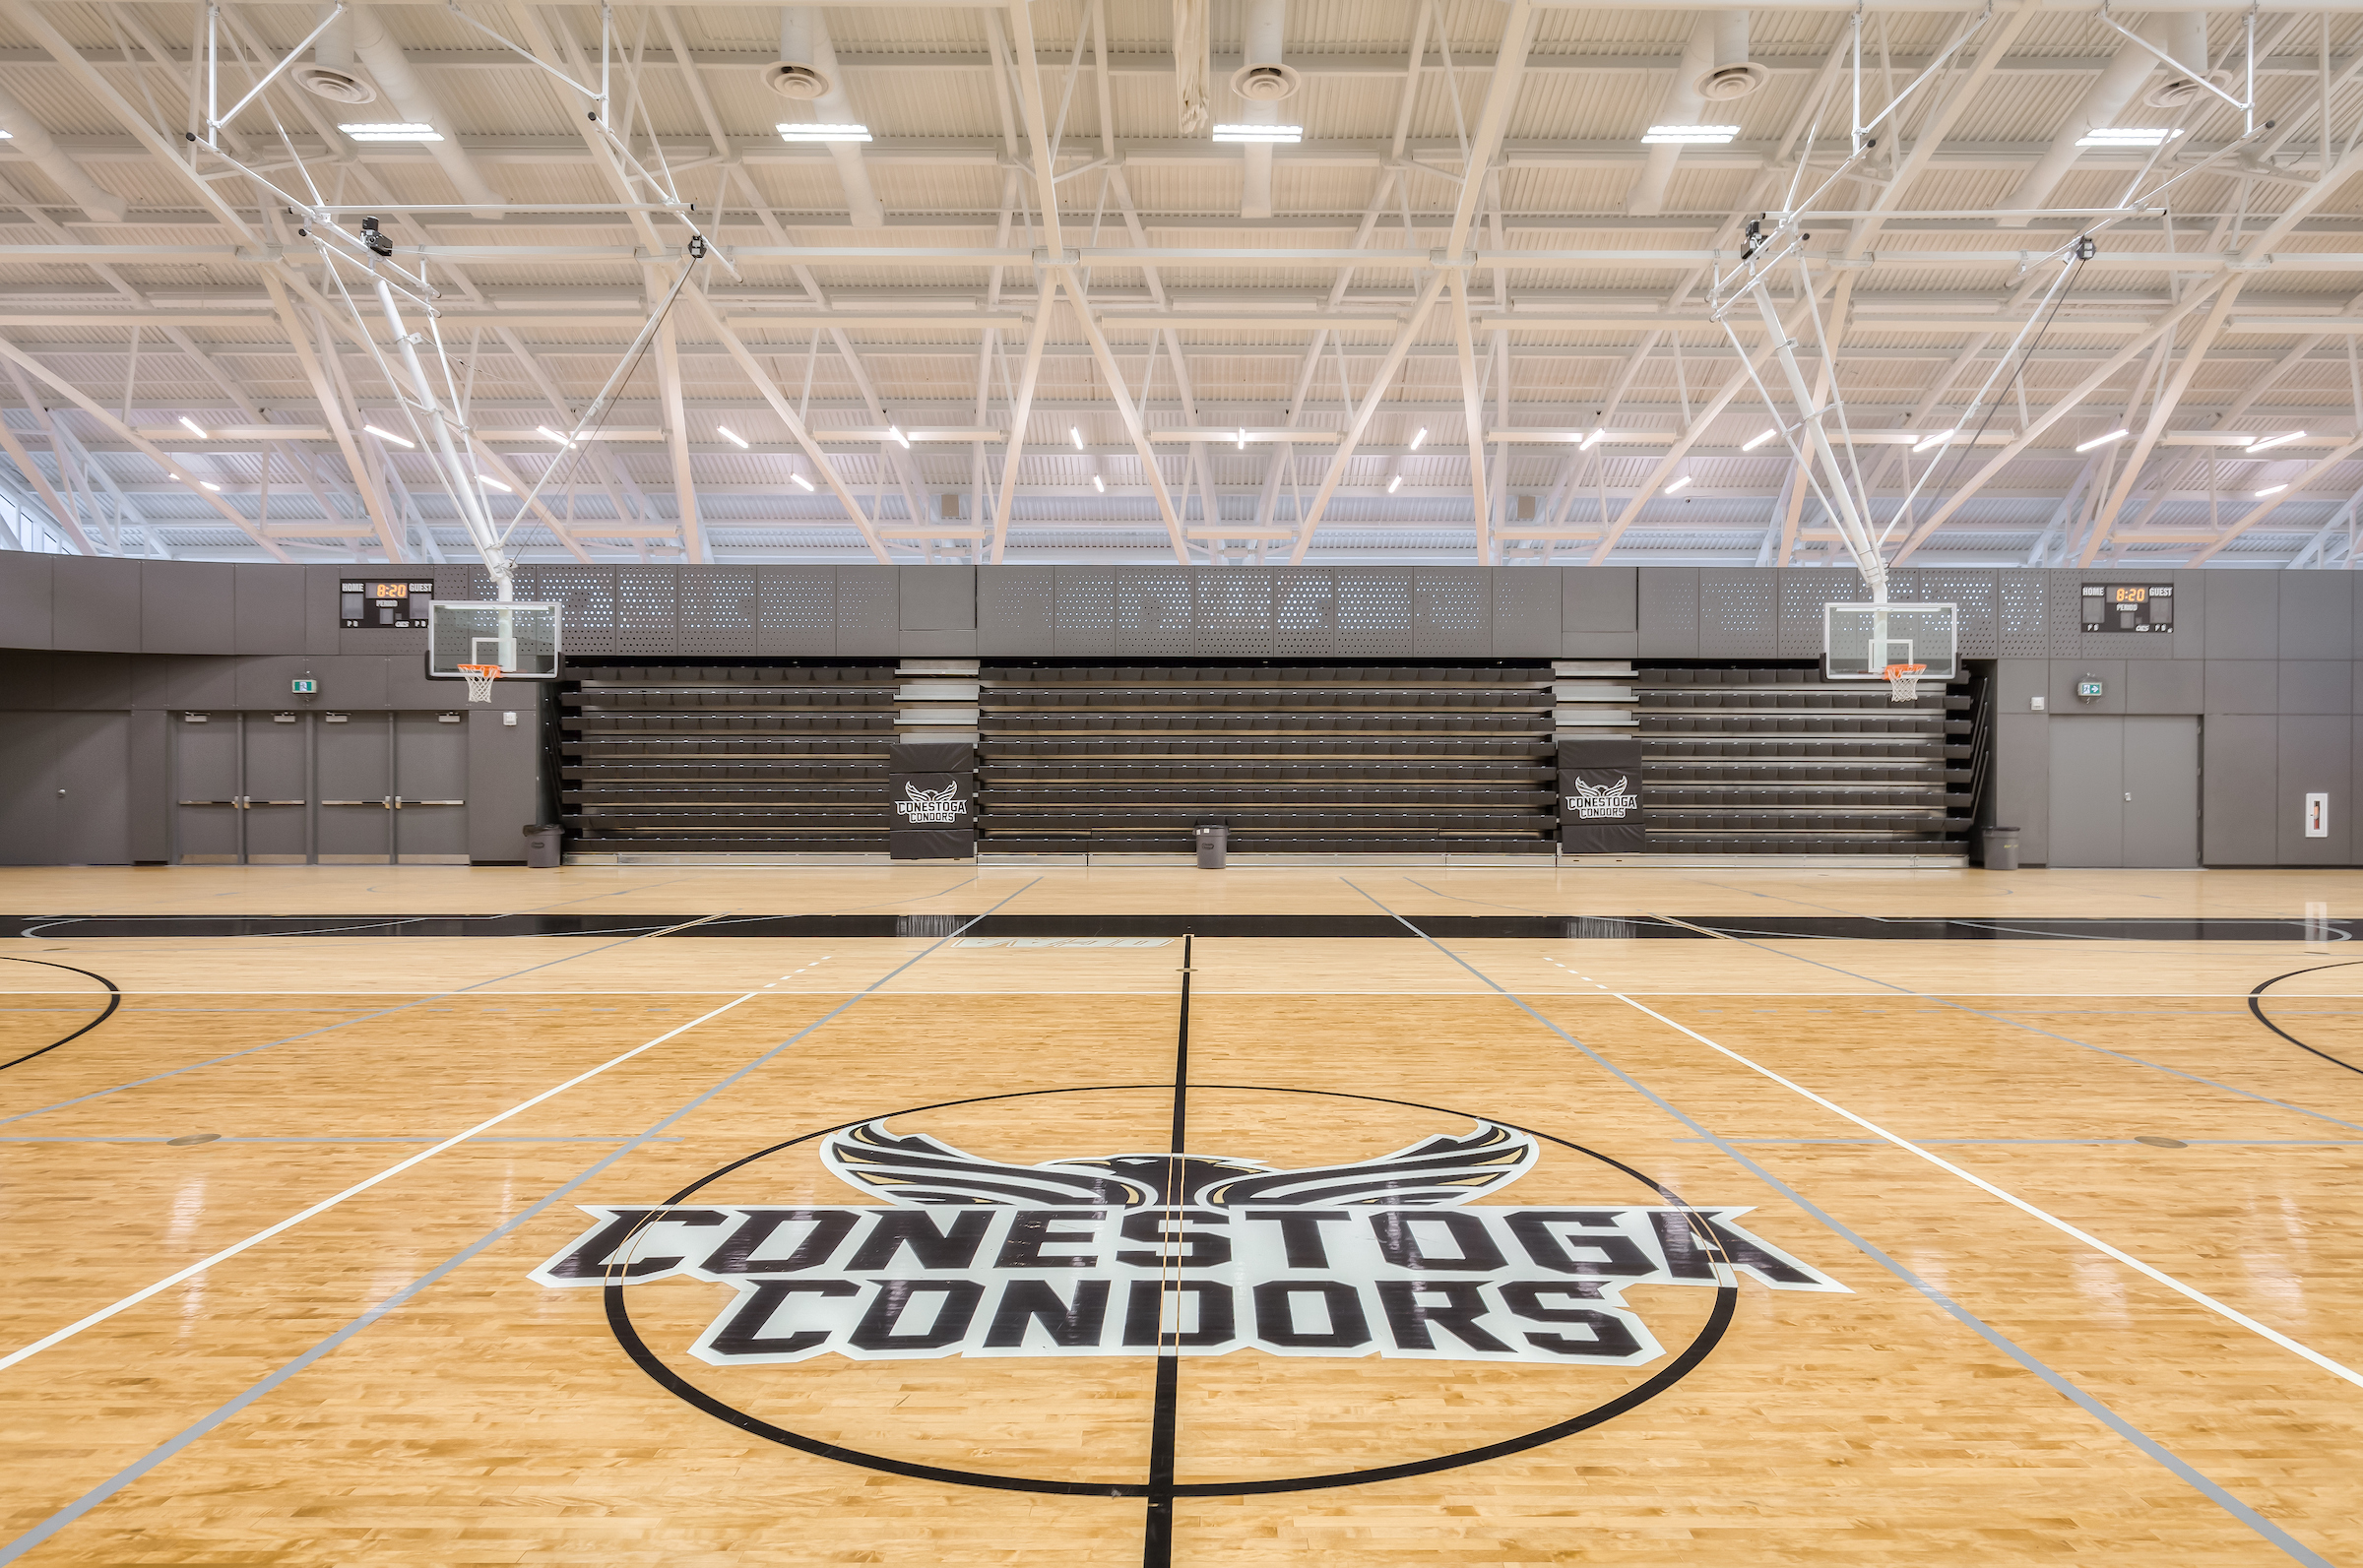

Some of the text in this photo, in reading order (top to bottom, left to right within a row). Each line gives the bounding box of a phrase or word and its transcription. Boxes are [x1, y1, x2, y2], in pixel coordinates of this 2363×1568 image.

[342, 583, 364, 593] HOME
[377, 584, 407, 597] 8:20
[409, 583, 433, 593] GUEST
[2082, 587, 2105, 596] HOME
[2149, 587, 2173, 596] GUEST
[2116, 588, 2145, 602] 8:20
[897, 801, 966, 813] CONESTOGA
[1567, 796, 1636, 809] CONESTOGA
[910, 812, 954, 822] CONDORS
[1579, 807, 1625, 818] CONDORS
[543, 1207, 1825, 1286] CONESTOGA
[707, 1278, 1645, 1358] CONDORS
